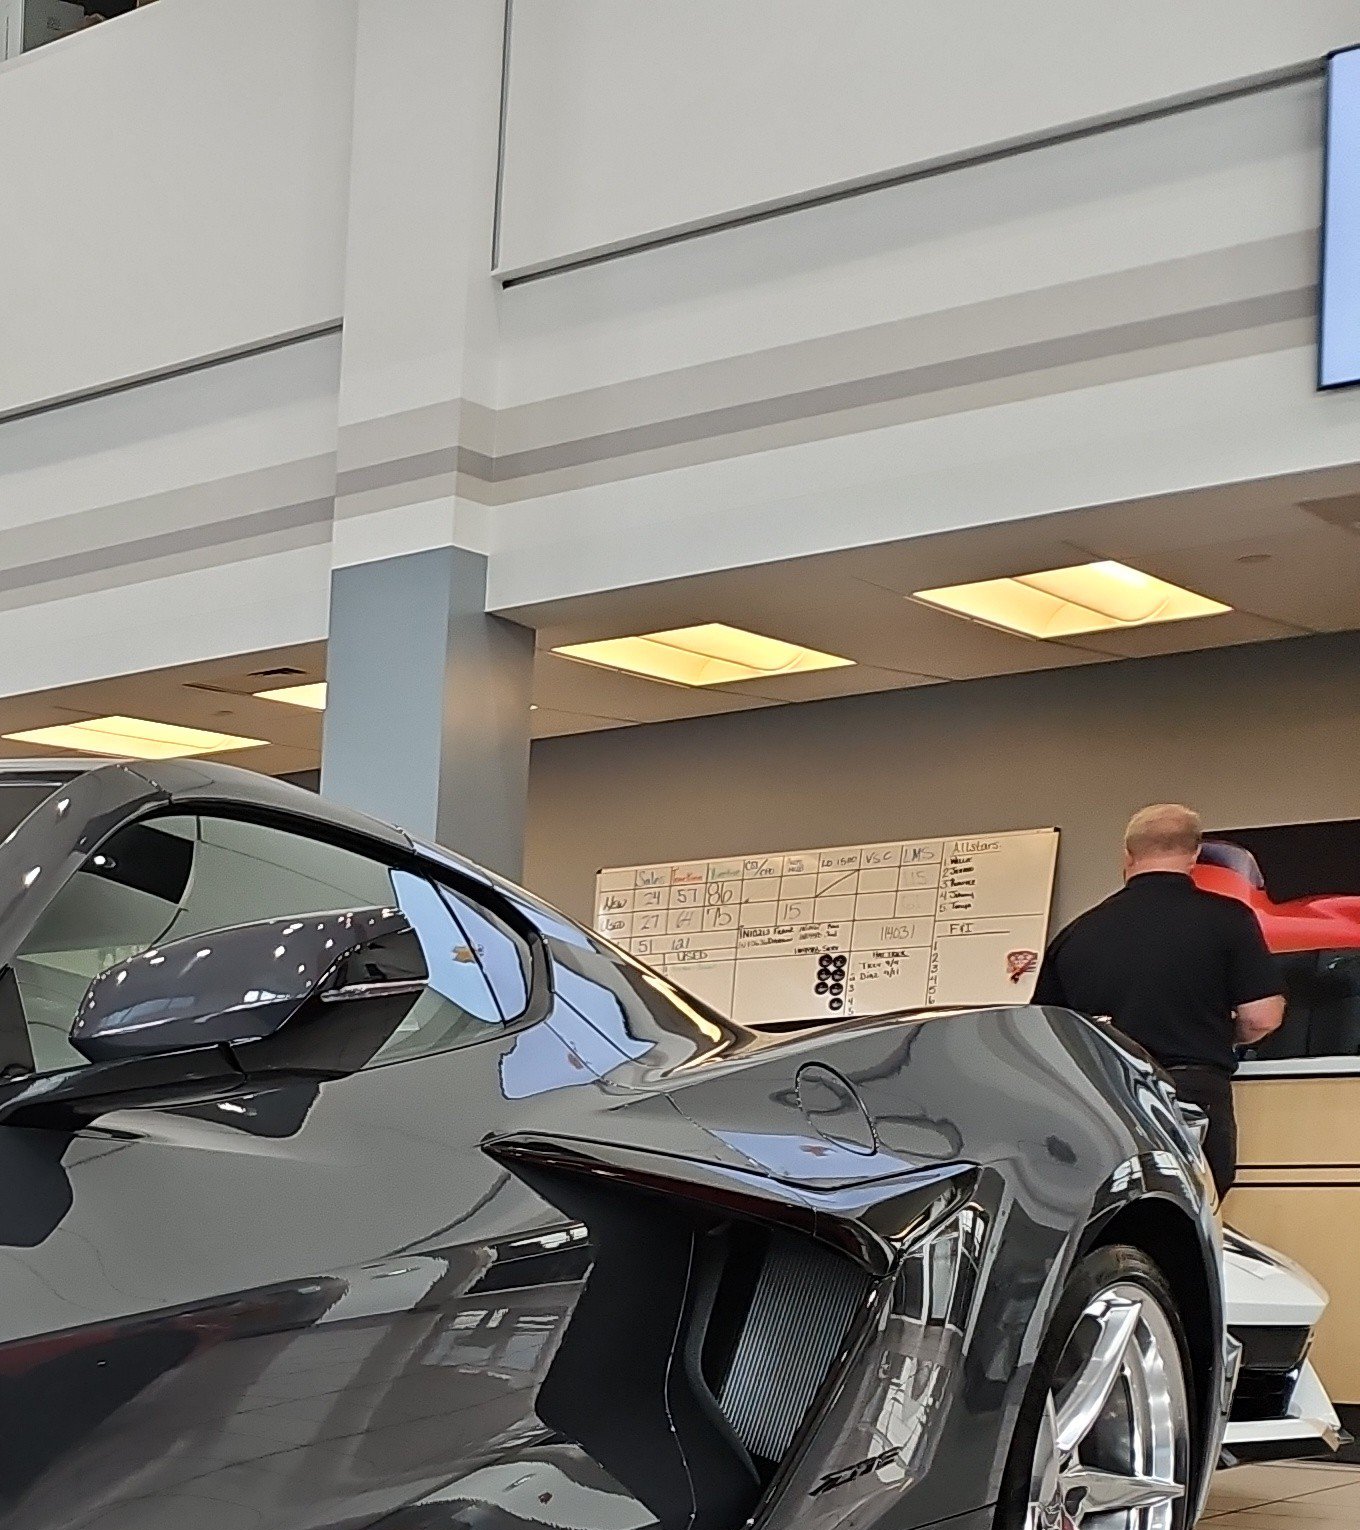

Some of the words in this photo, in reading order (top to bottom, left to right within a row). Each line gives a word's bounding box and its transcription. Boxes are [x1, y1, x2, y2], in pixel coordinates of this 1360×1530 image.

[676, 888, 698, 903] 57
[707, 881, 733, 905] 86
[783, 902, 802, 919] 15
[638, 939, 653, 953] 51
